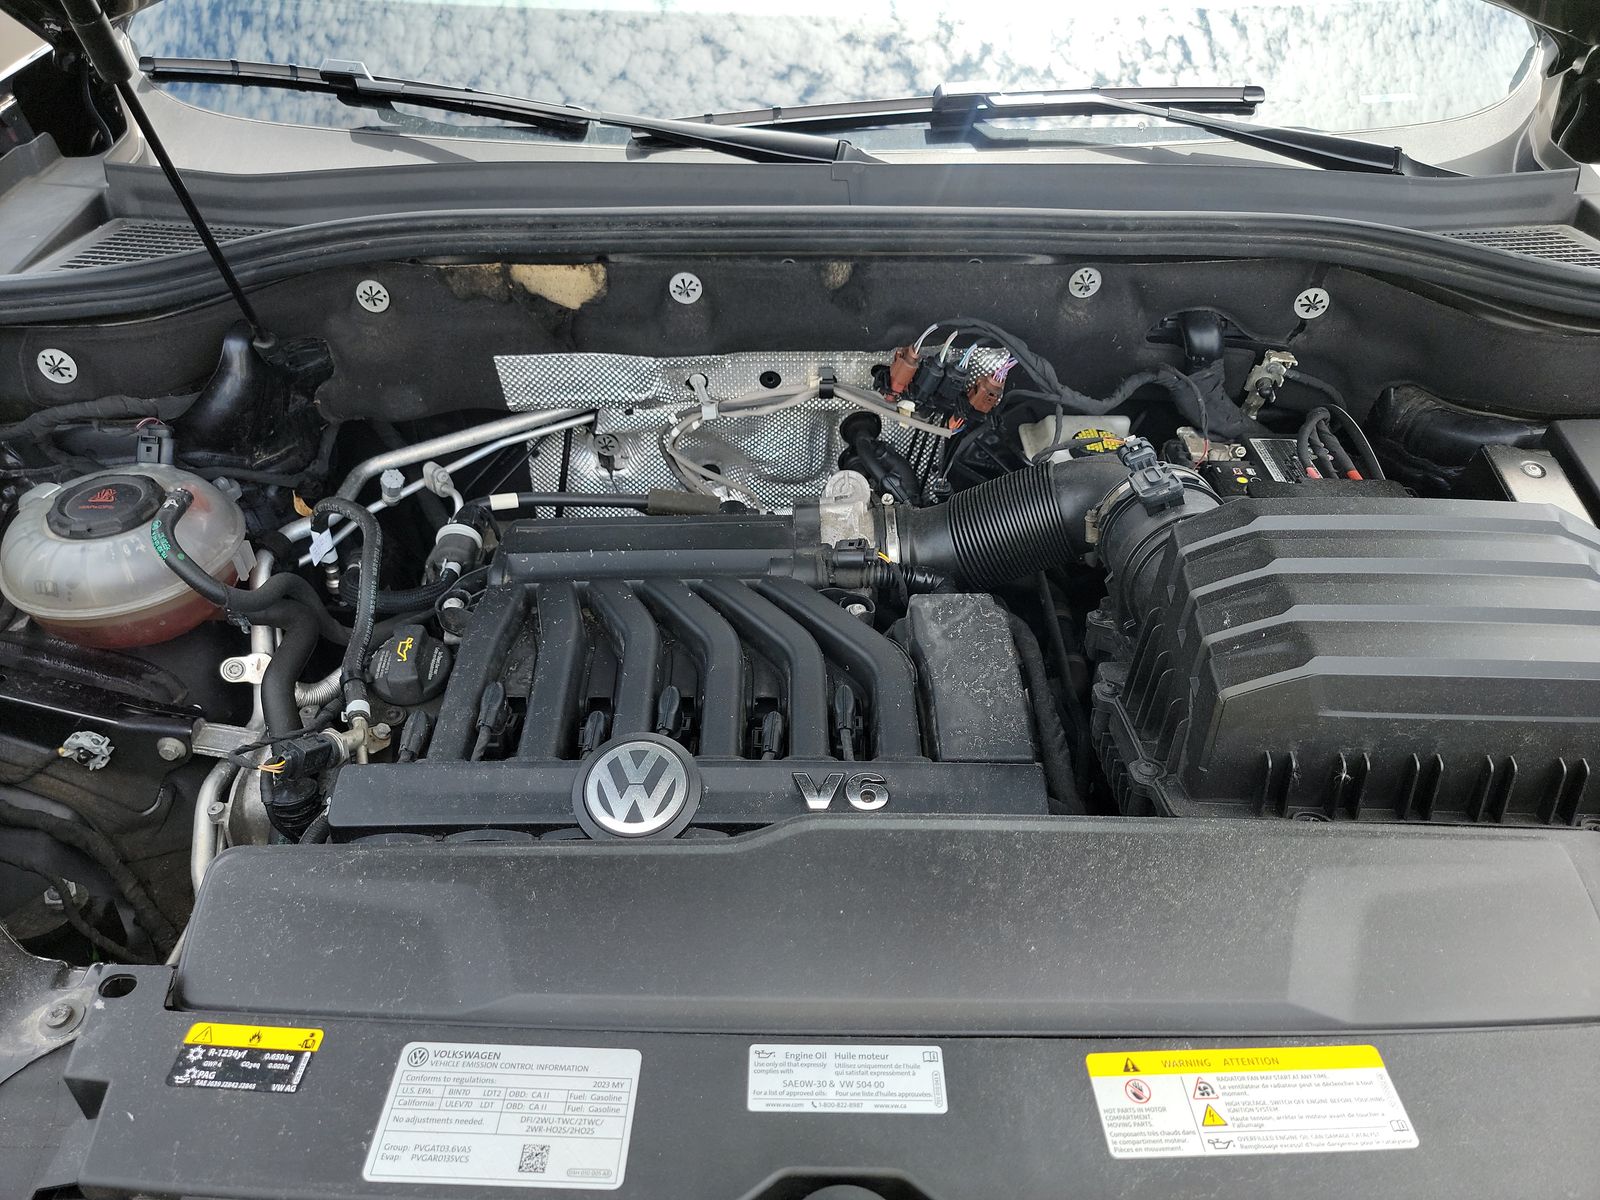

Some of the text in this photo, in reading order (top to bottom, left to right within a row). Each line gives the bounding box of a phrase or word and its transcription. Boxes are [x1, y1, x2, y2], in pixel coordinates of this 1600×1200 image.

[792, 772, 889, 811] V6
[208, 1048, 248, 1059] R-1234yf
[433, 1050, 501, 1060] VOLKSWAGEN
[785, 1052, 813, 1060] Engine
[285, 1054, 294, 1063] kg
[1223, 1057, 1280, 1066] ATTENTION
[536, 1064, 589, 1072] INFORMATION
[1162, 1059, 1211, 1068] WARNING
[198, 1071, 216, 1079] PAG
[453, 1077, 496, 1085] regulations:
[405, 1116, 453, 1125] adjustments
[384, 1143, 410, 1152] Group:
[381, 1153, 402, 1162] Evap:
